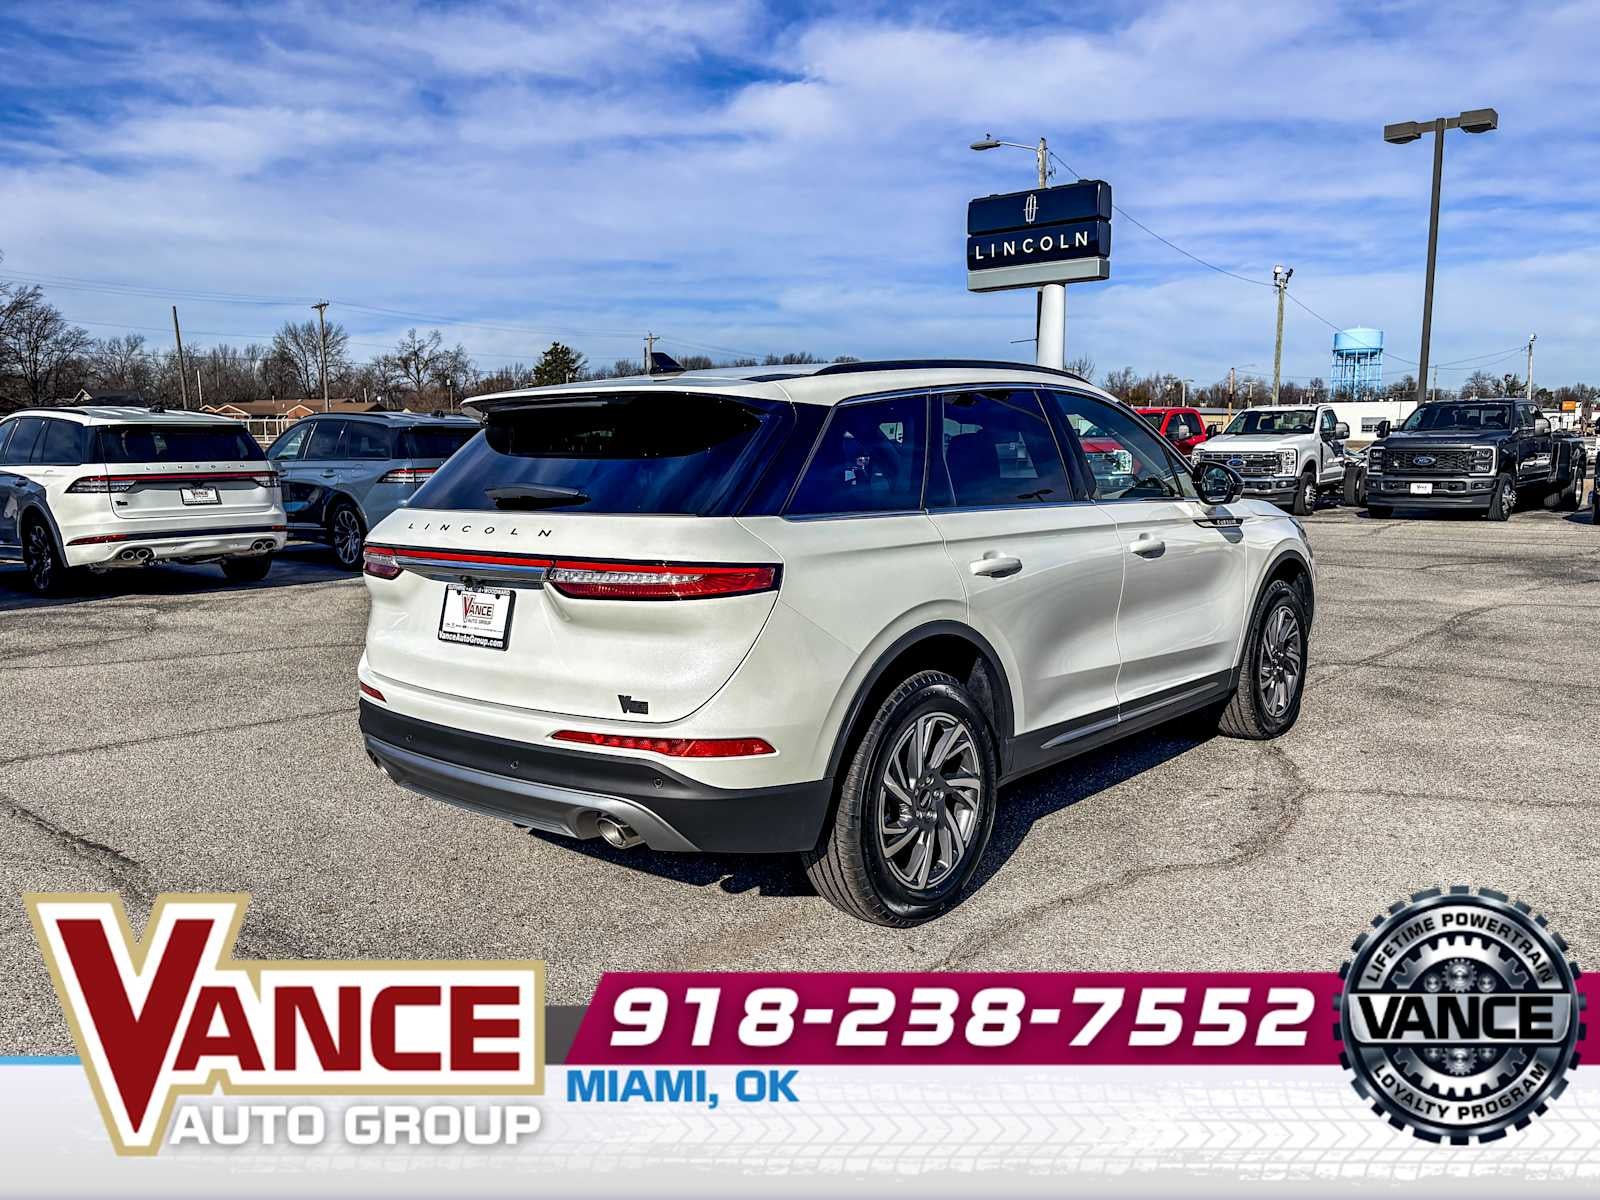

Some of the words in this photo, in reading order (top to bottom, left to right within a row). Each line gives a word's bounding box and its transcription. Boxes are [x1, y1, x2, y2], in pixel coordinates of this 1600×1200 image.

[975, 230, 1088, 260] LINCOLN
[145, 463, 246, 471] LINCOLN
[408, 522, 552, 537] LINCOLN
[463, 596, 493, 618] VANCE
[439, 631, 504, 648] VanceAutoGroup.com
